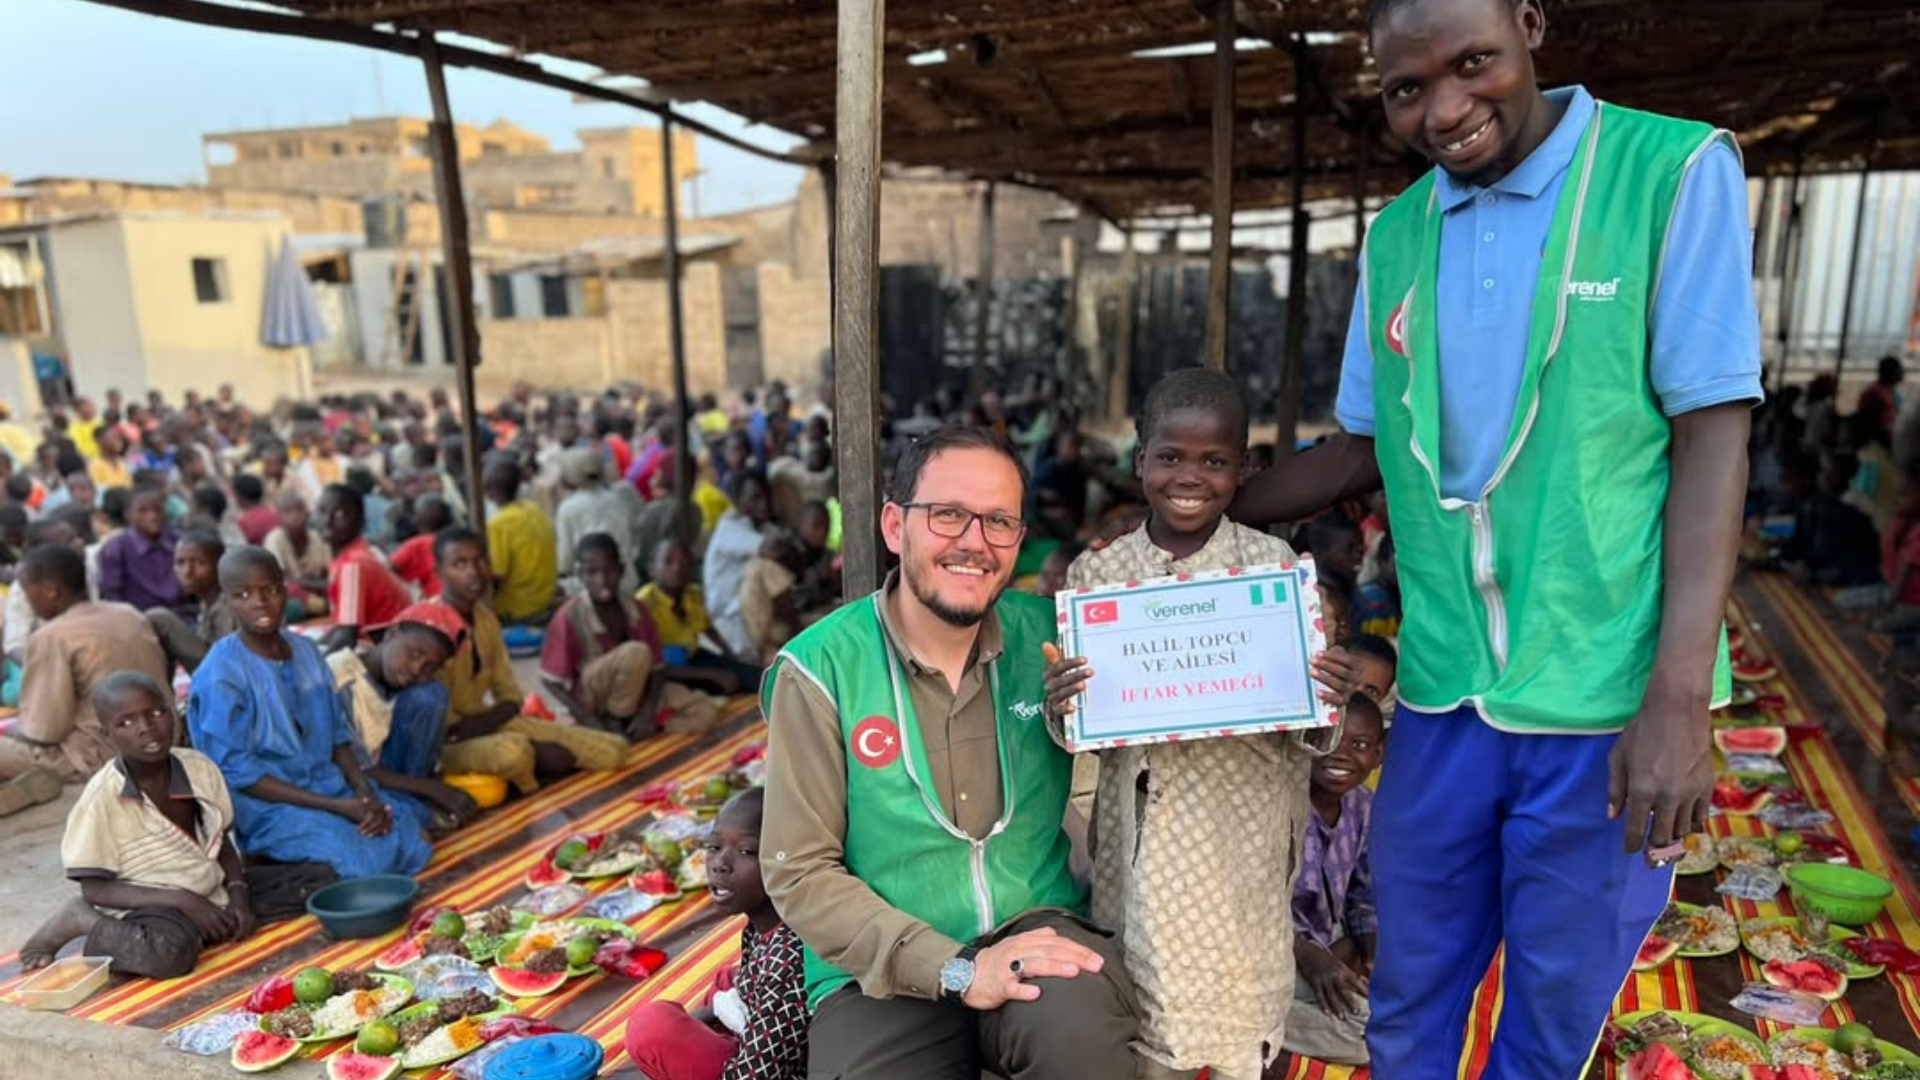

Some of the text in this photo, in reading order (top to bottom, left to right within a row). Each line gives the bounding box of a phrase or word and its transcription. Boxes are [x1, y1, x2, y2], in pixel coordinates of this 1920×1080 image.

[1151, 597, 1216, 618] verenel
[1123, 636, 1183, 657] HALİL
[1142, 658, 1168, 673] VE
